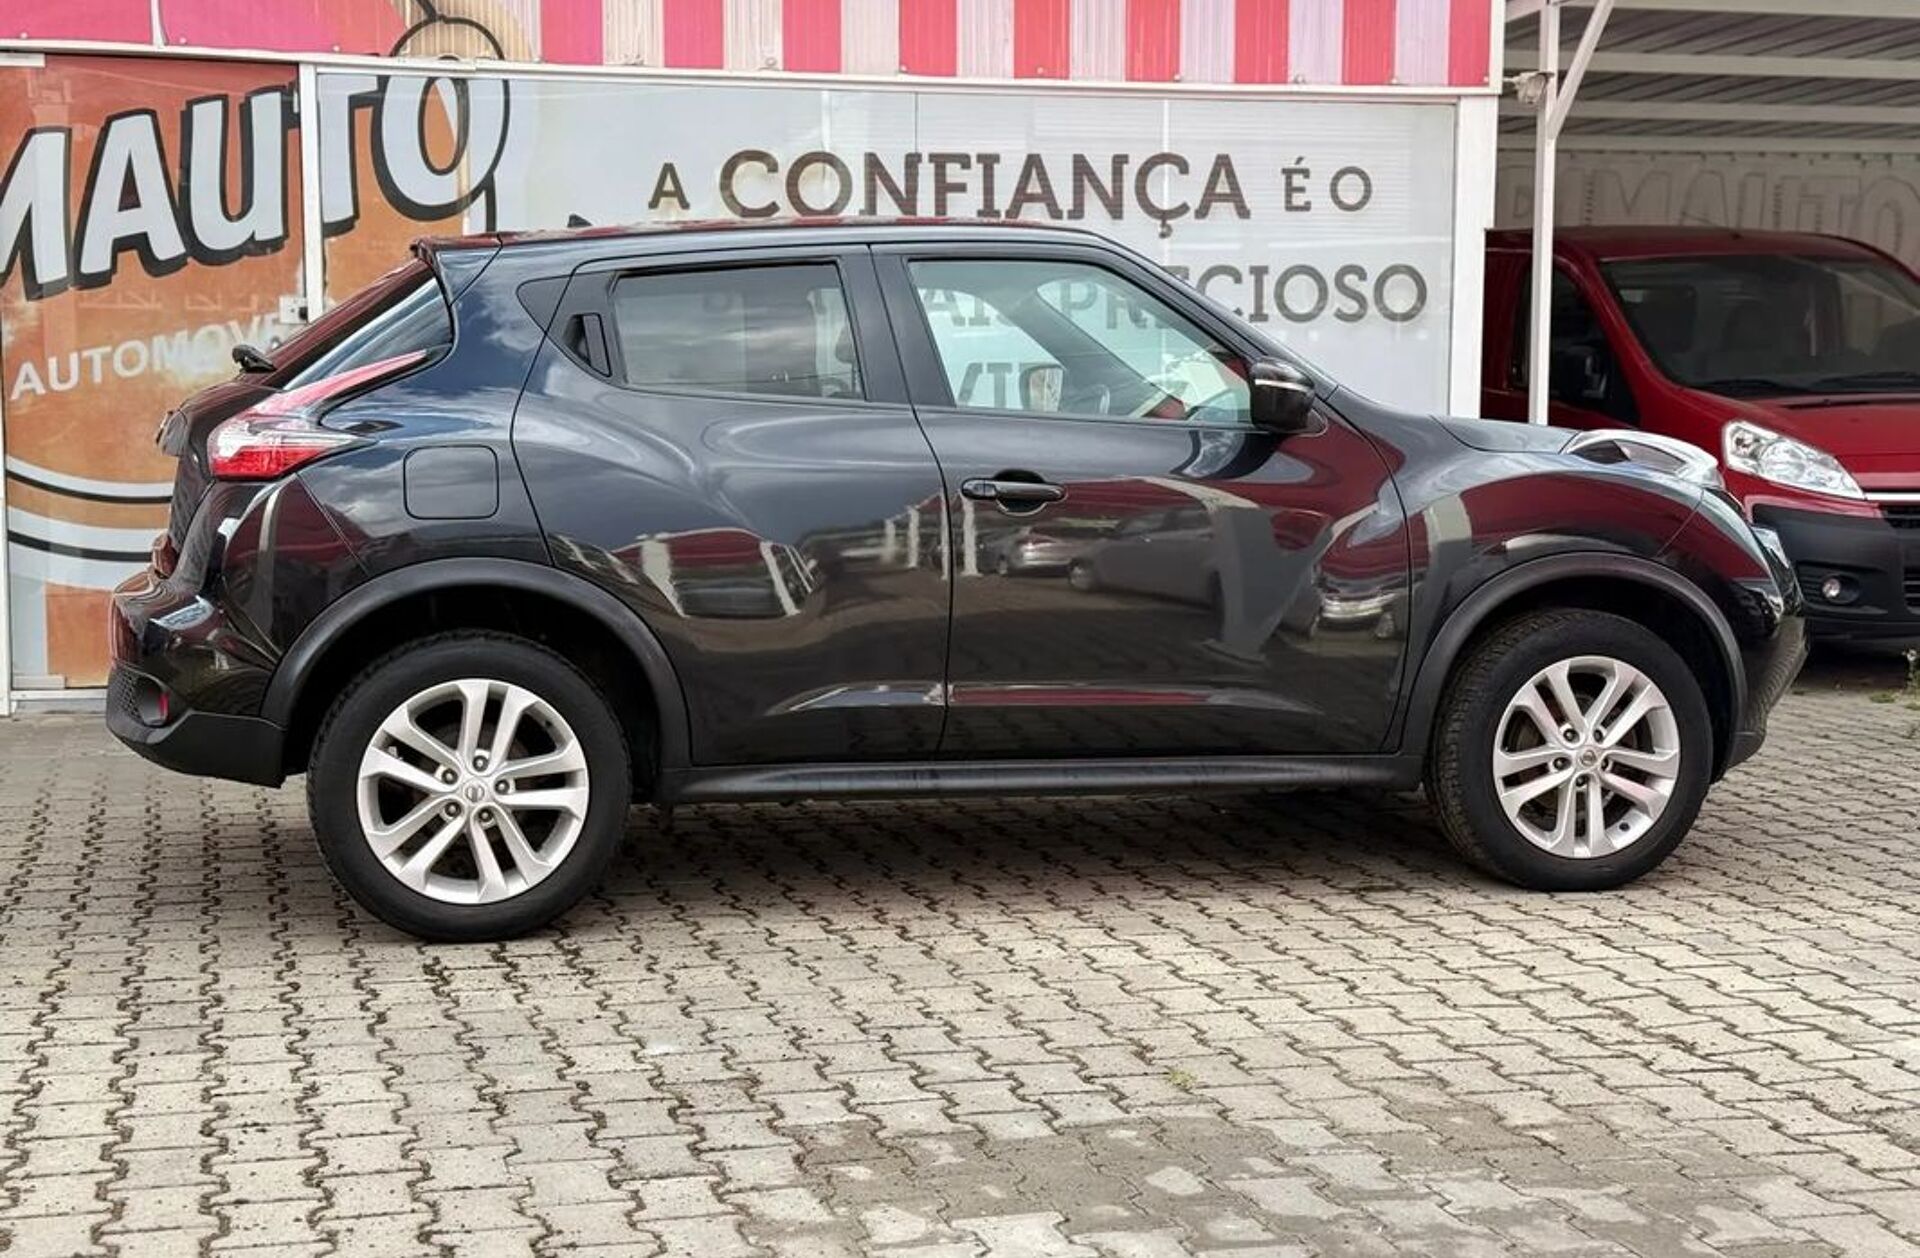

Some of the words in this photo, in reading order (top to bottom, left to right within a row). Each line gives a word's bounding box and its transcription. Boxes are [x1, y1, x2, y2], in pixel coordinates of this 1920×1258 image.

[648, 162, 691, 210] A
[719, 149, 1251, 239] CONFIANÇA
[1281, 156, 1312, 212] É
[1329, 166, 1372, 212] O
